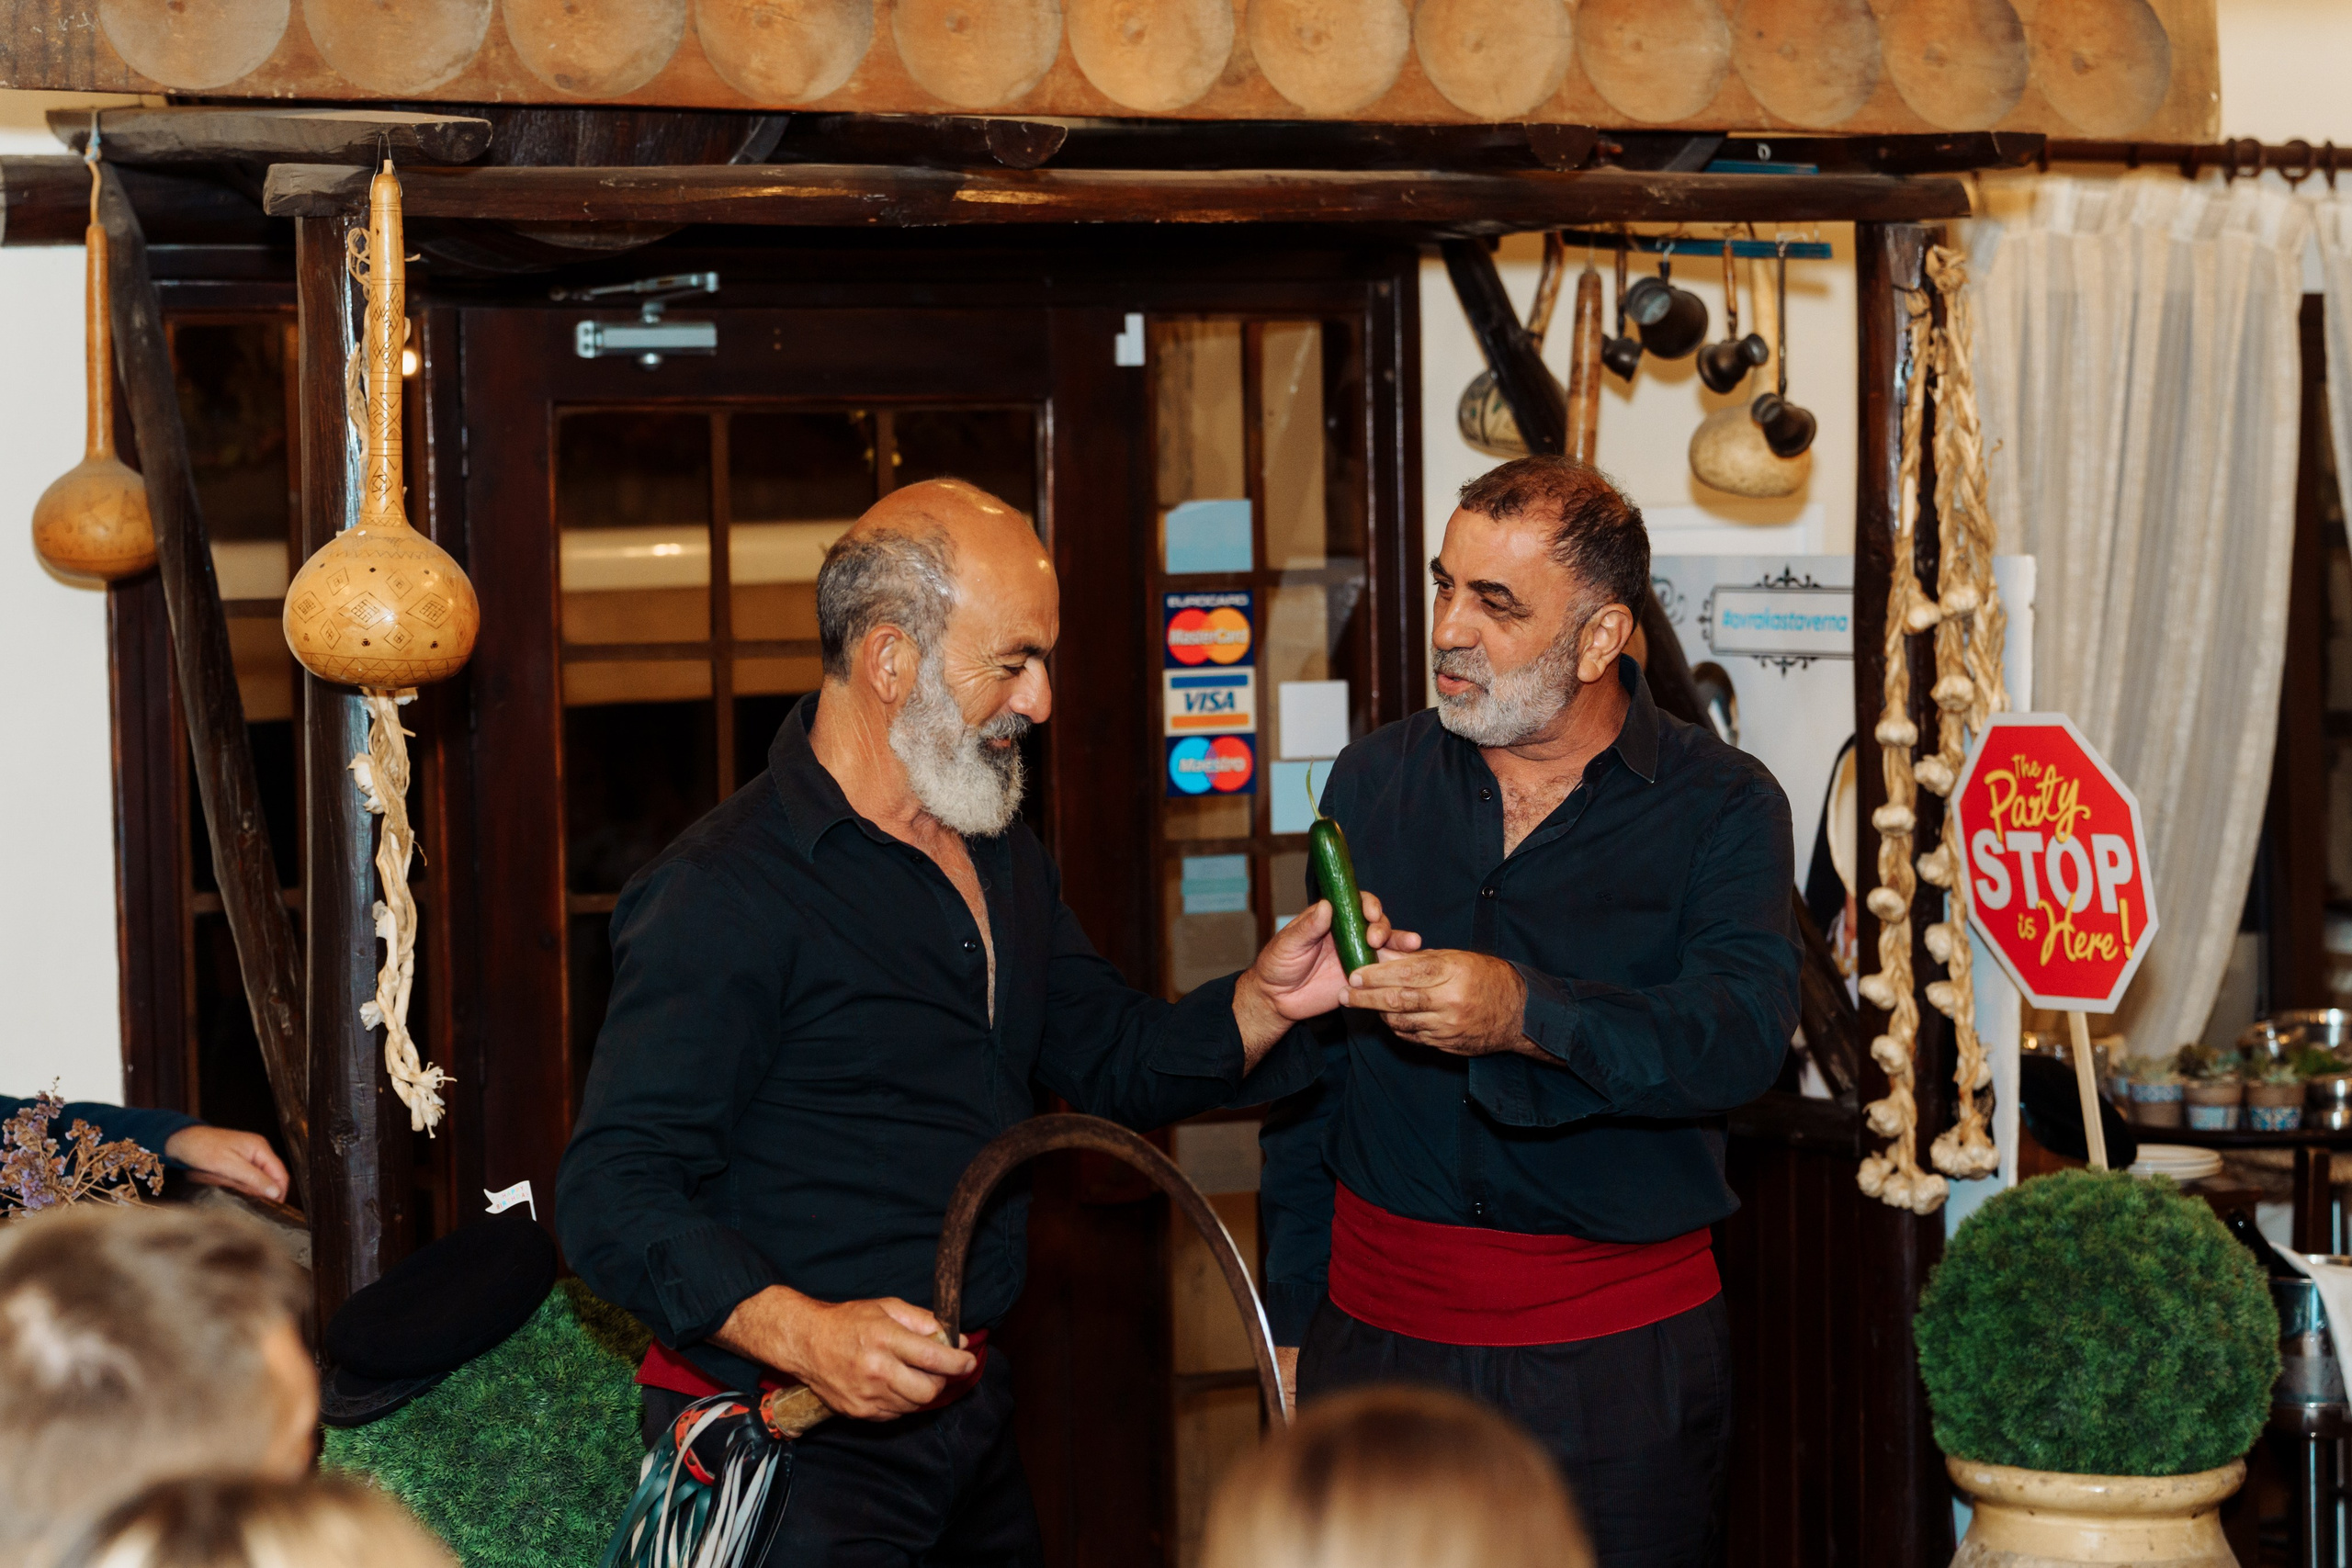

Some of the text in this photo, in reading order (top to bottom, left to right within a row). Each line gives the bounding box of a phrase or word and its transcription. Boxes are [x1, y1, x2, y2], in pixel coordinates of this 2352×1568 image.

[1168, 627, 1250, 646] MasterCard
[1184, 691, 1236, 713] VISA
[1178, 756, 1247, 773] Maestro
[2011, 753, 2041, 779] The
[1984, 764, 2091, 843] Party
[1972, 829, 2133, 914] STOP
[2018, 891, 2132, 966] is Here!
